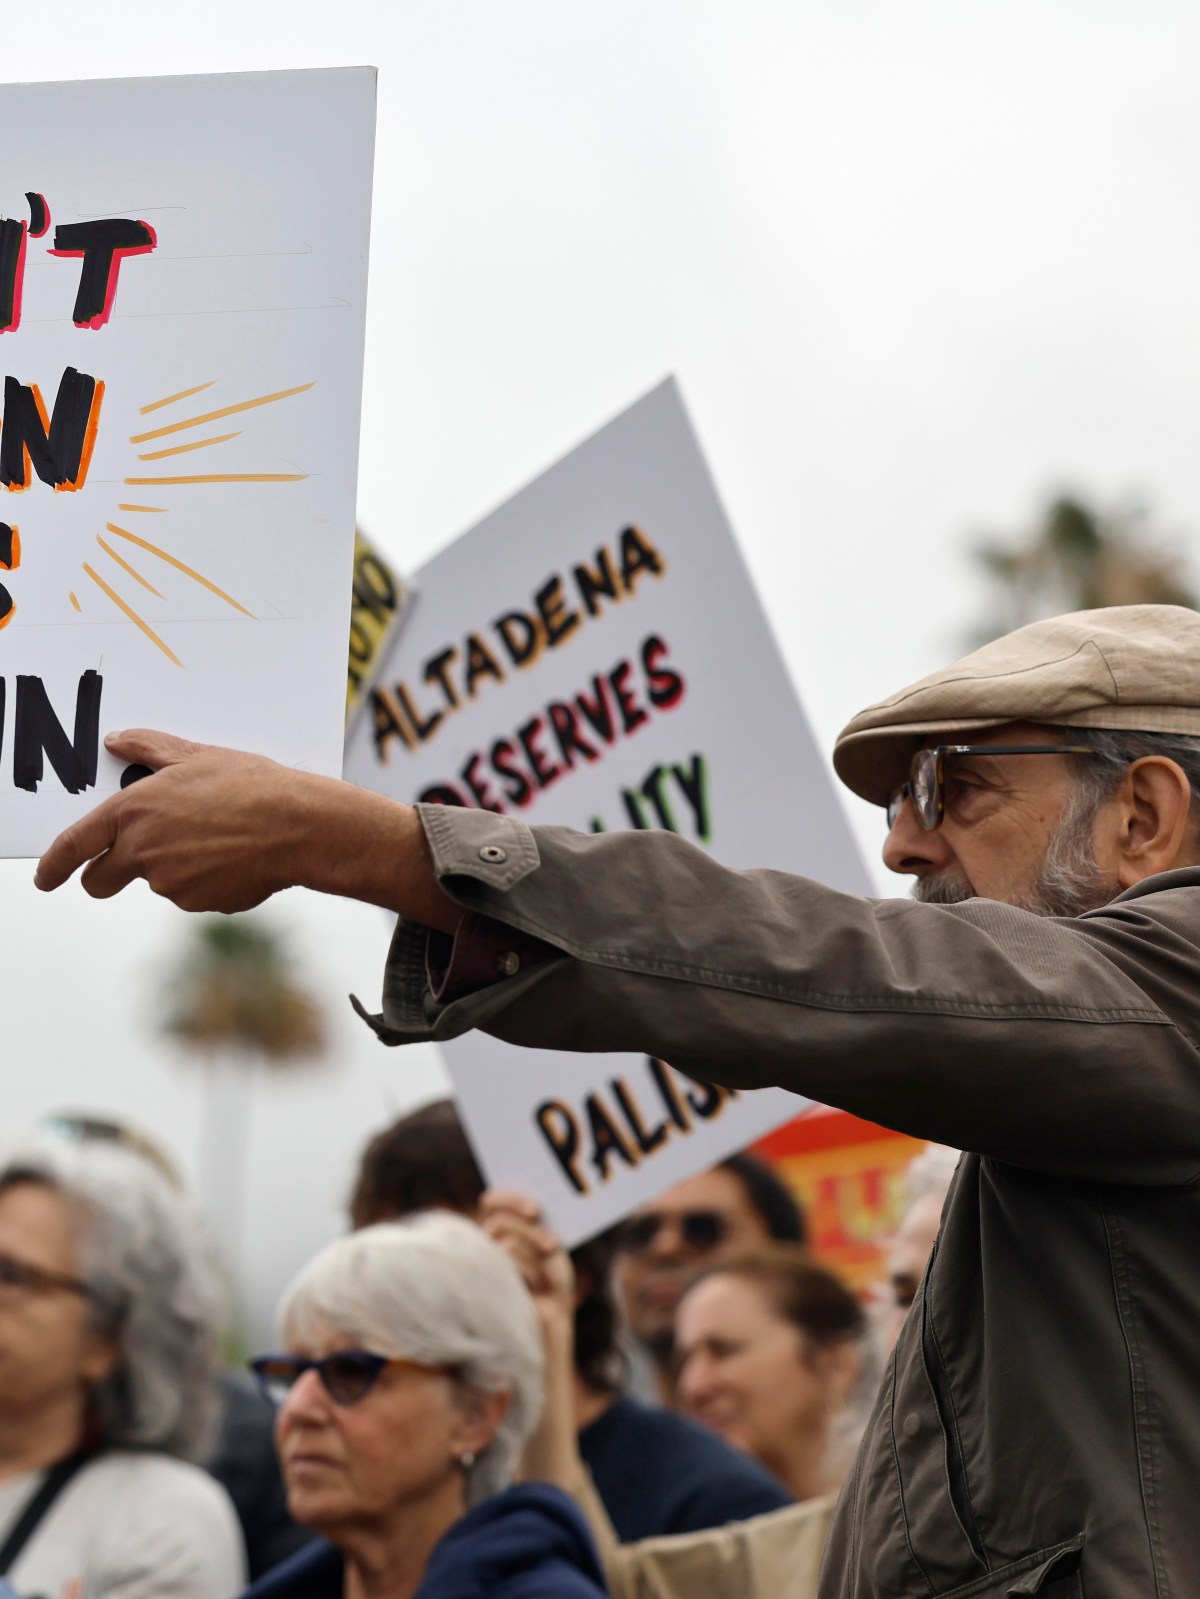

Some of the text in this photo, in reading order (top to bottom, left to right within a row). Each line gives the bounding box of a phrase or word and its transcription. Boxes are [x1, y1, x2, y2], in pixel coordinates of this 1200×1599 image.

[369, 523, 667, 765] ALTADENA
[590, 751, 712, 843] ITY
[535, 1056, 740, 1194] PALIS
